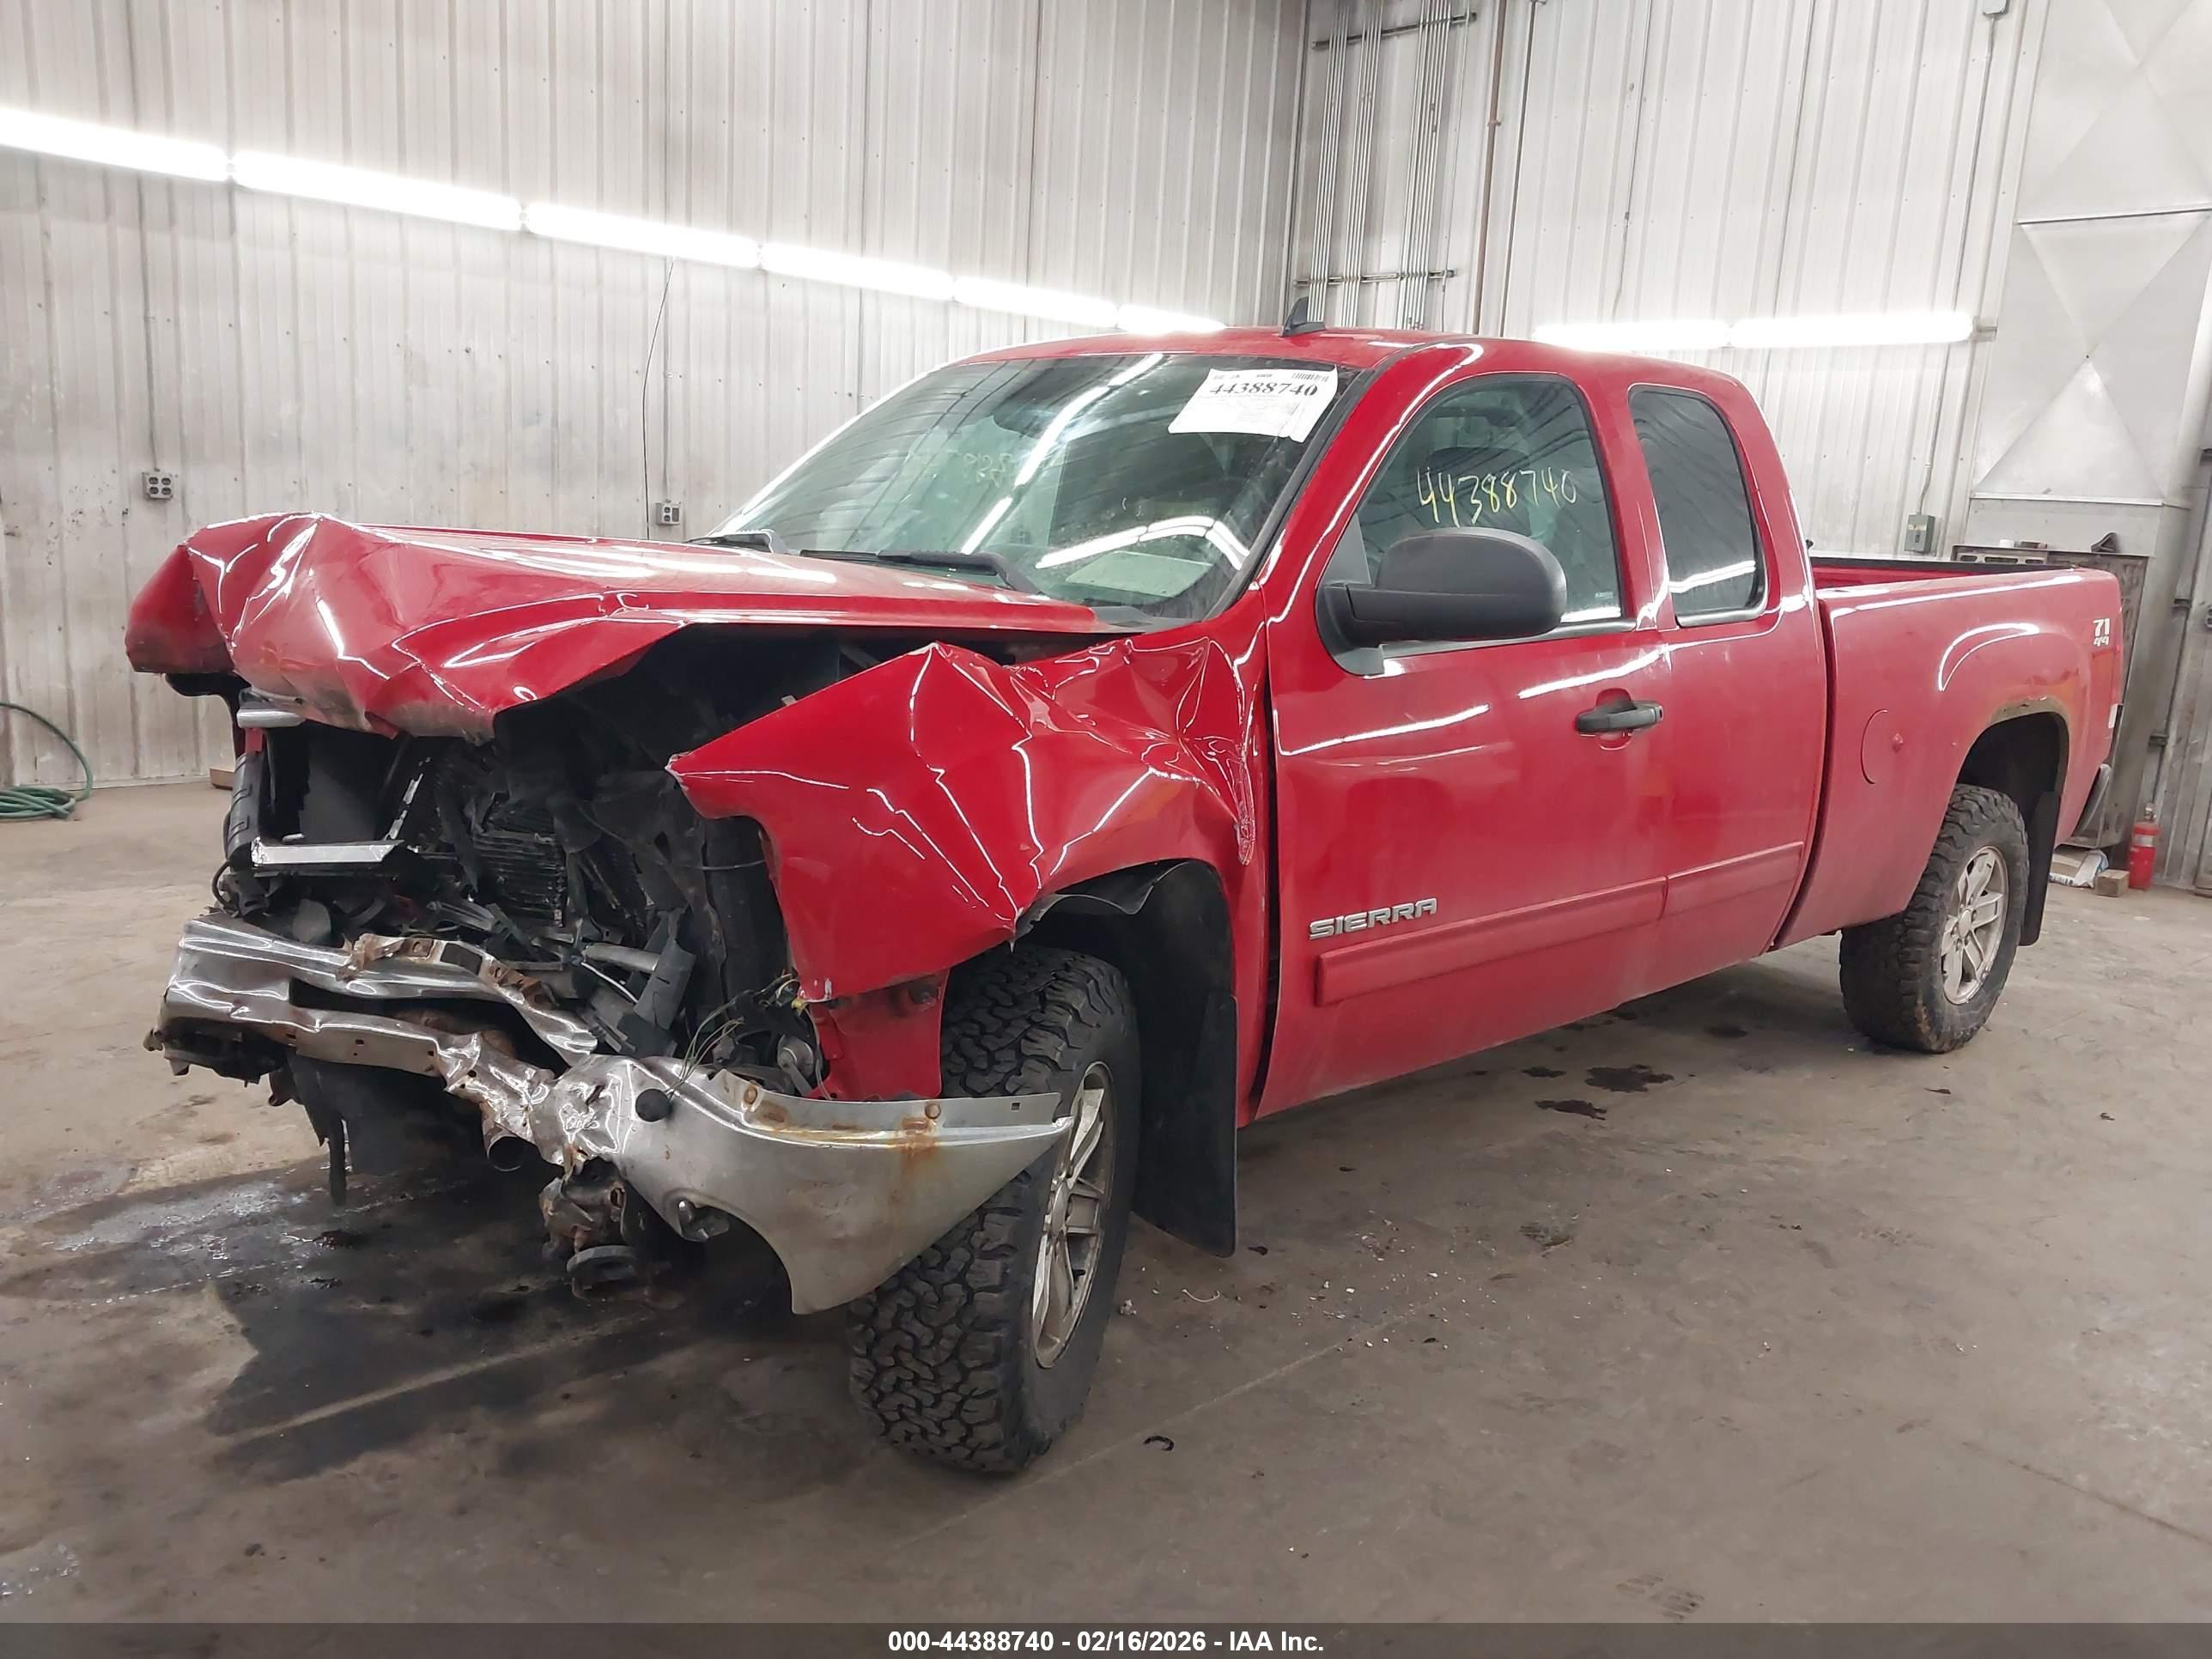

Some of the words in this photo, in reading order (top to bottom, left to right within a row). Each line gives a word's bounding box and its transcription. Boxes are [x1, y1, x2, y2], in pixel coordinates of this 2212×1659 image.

[1210, 382, 1318, 396] 44388740
[1417, 466, 1577, 528] 44388740
[1310, 897, 1437, 940] SIERRA
